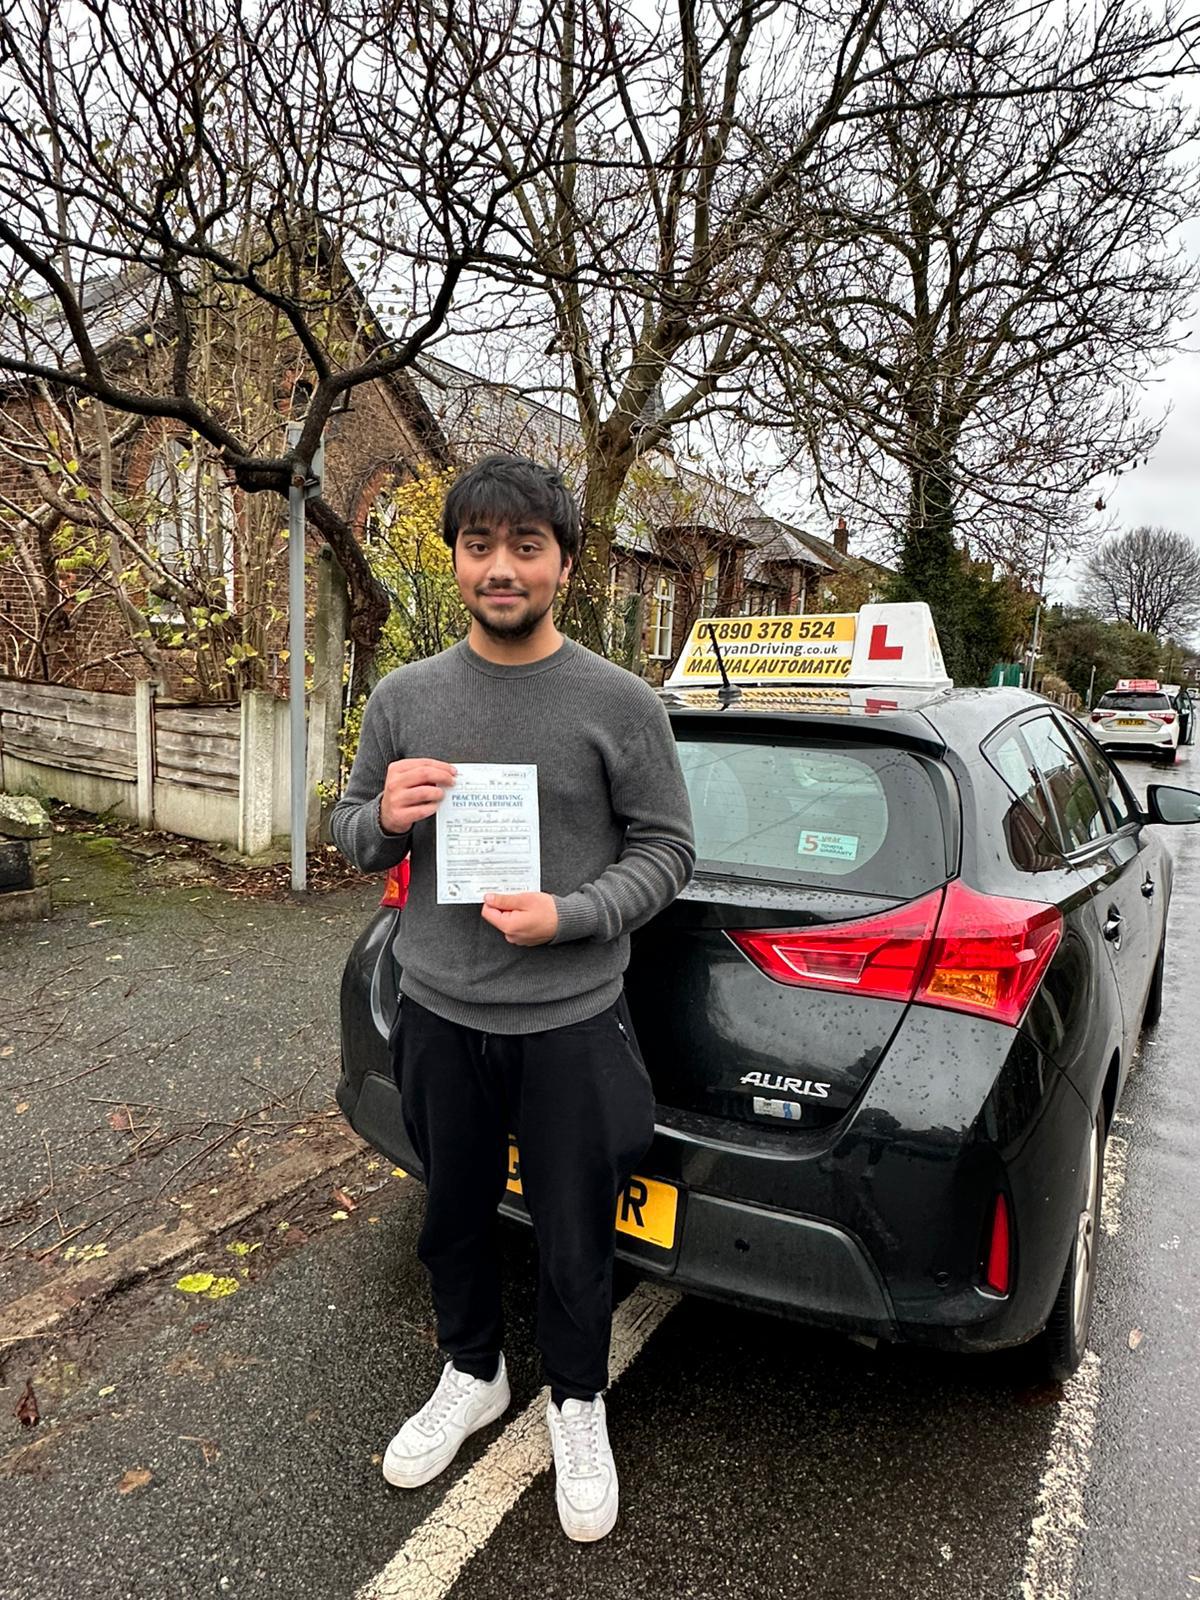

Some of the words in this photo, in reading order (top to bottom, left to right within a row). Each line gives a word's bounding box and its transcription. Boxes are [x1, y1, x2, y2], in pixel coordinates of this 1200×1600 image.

[697, 622, 752, 639] 07890
[758, 621, 793, 639] 378
[798, 621, 836, 639] 524
[868, 624, 904, 660] L
[803, 834, 818, 851] 5
[740, 1071, 831, 1098] AURIS
